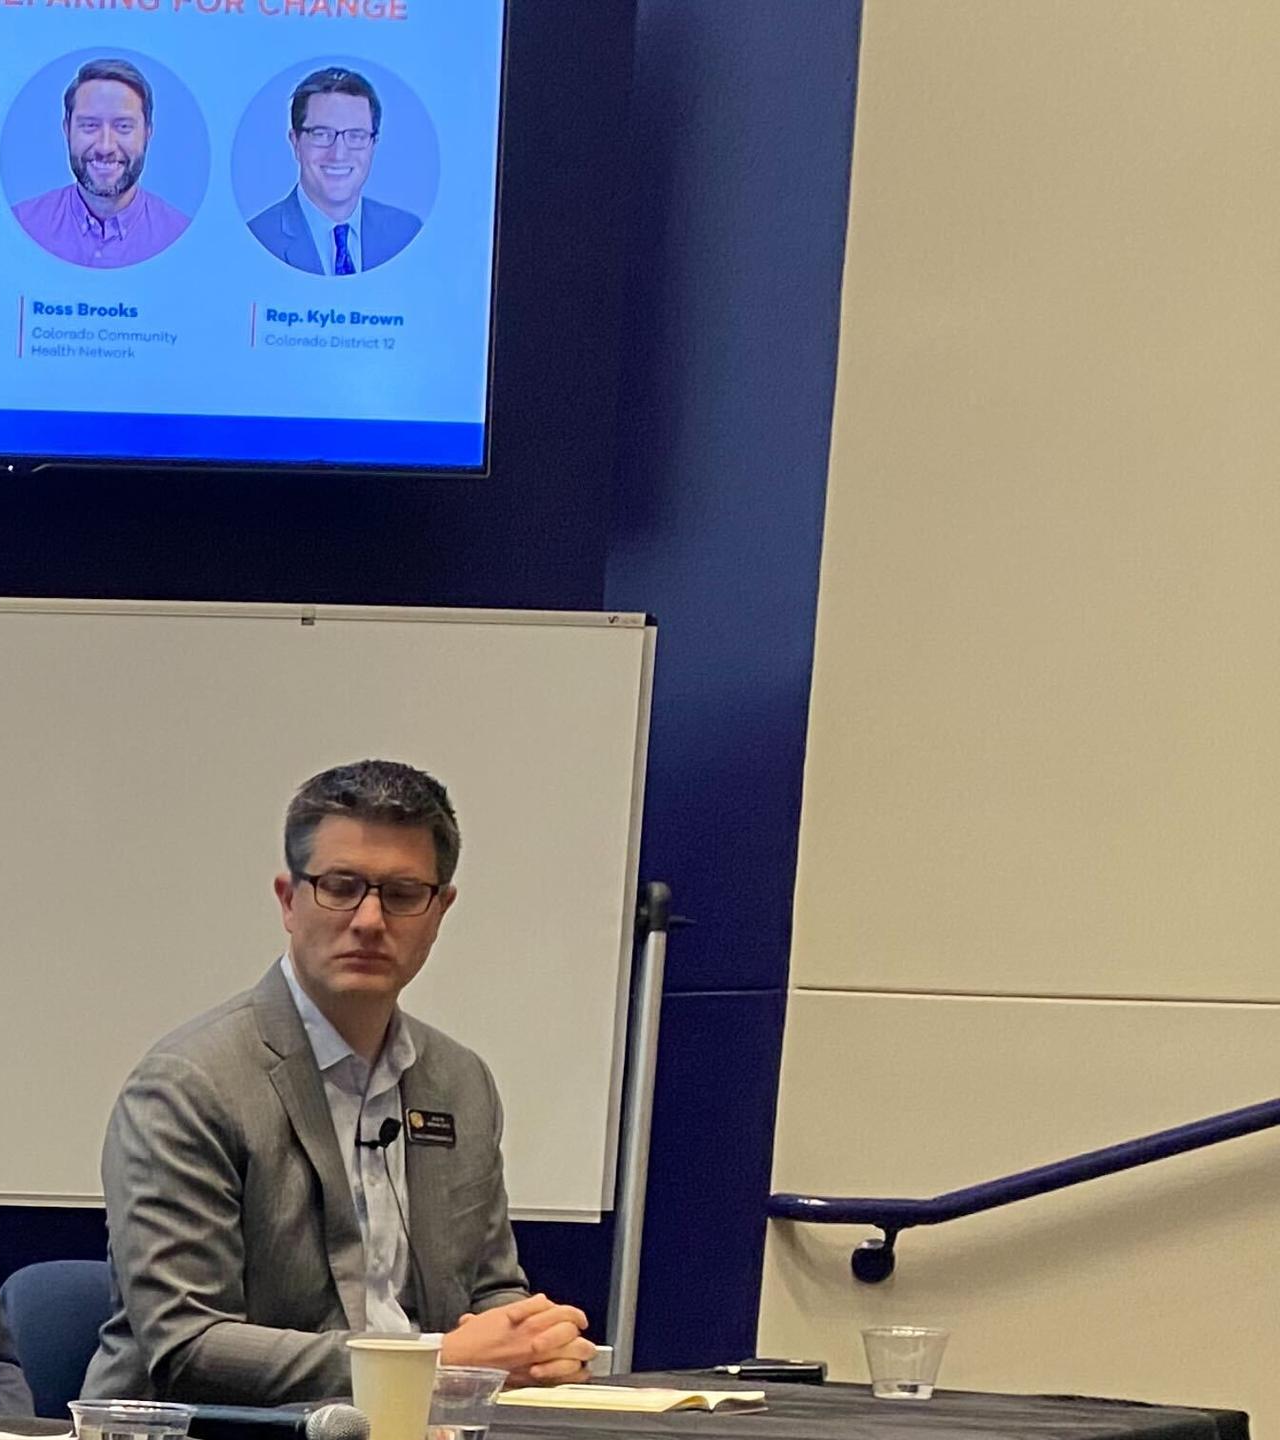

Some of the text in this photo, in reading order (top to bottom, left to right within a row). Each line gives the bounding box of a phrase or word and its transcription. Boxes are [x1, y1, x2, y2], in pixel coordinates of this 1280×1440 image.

[260, 0, 408, 20] CHANGE
[33, 301, 138, 318] Ross Brooks
[266, 308, 404, 328] Rep. Kyle Brown
[32, 326, 178, 346] Colorado Community
[265, 334, 396, 350] Colorado District 12
[31, 344, 136, 359] Health Network
